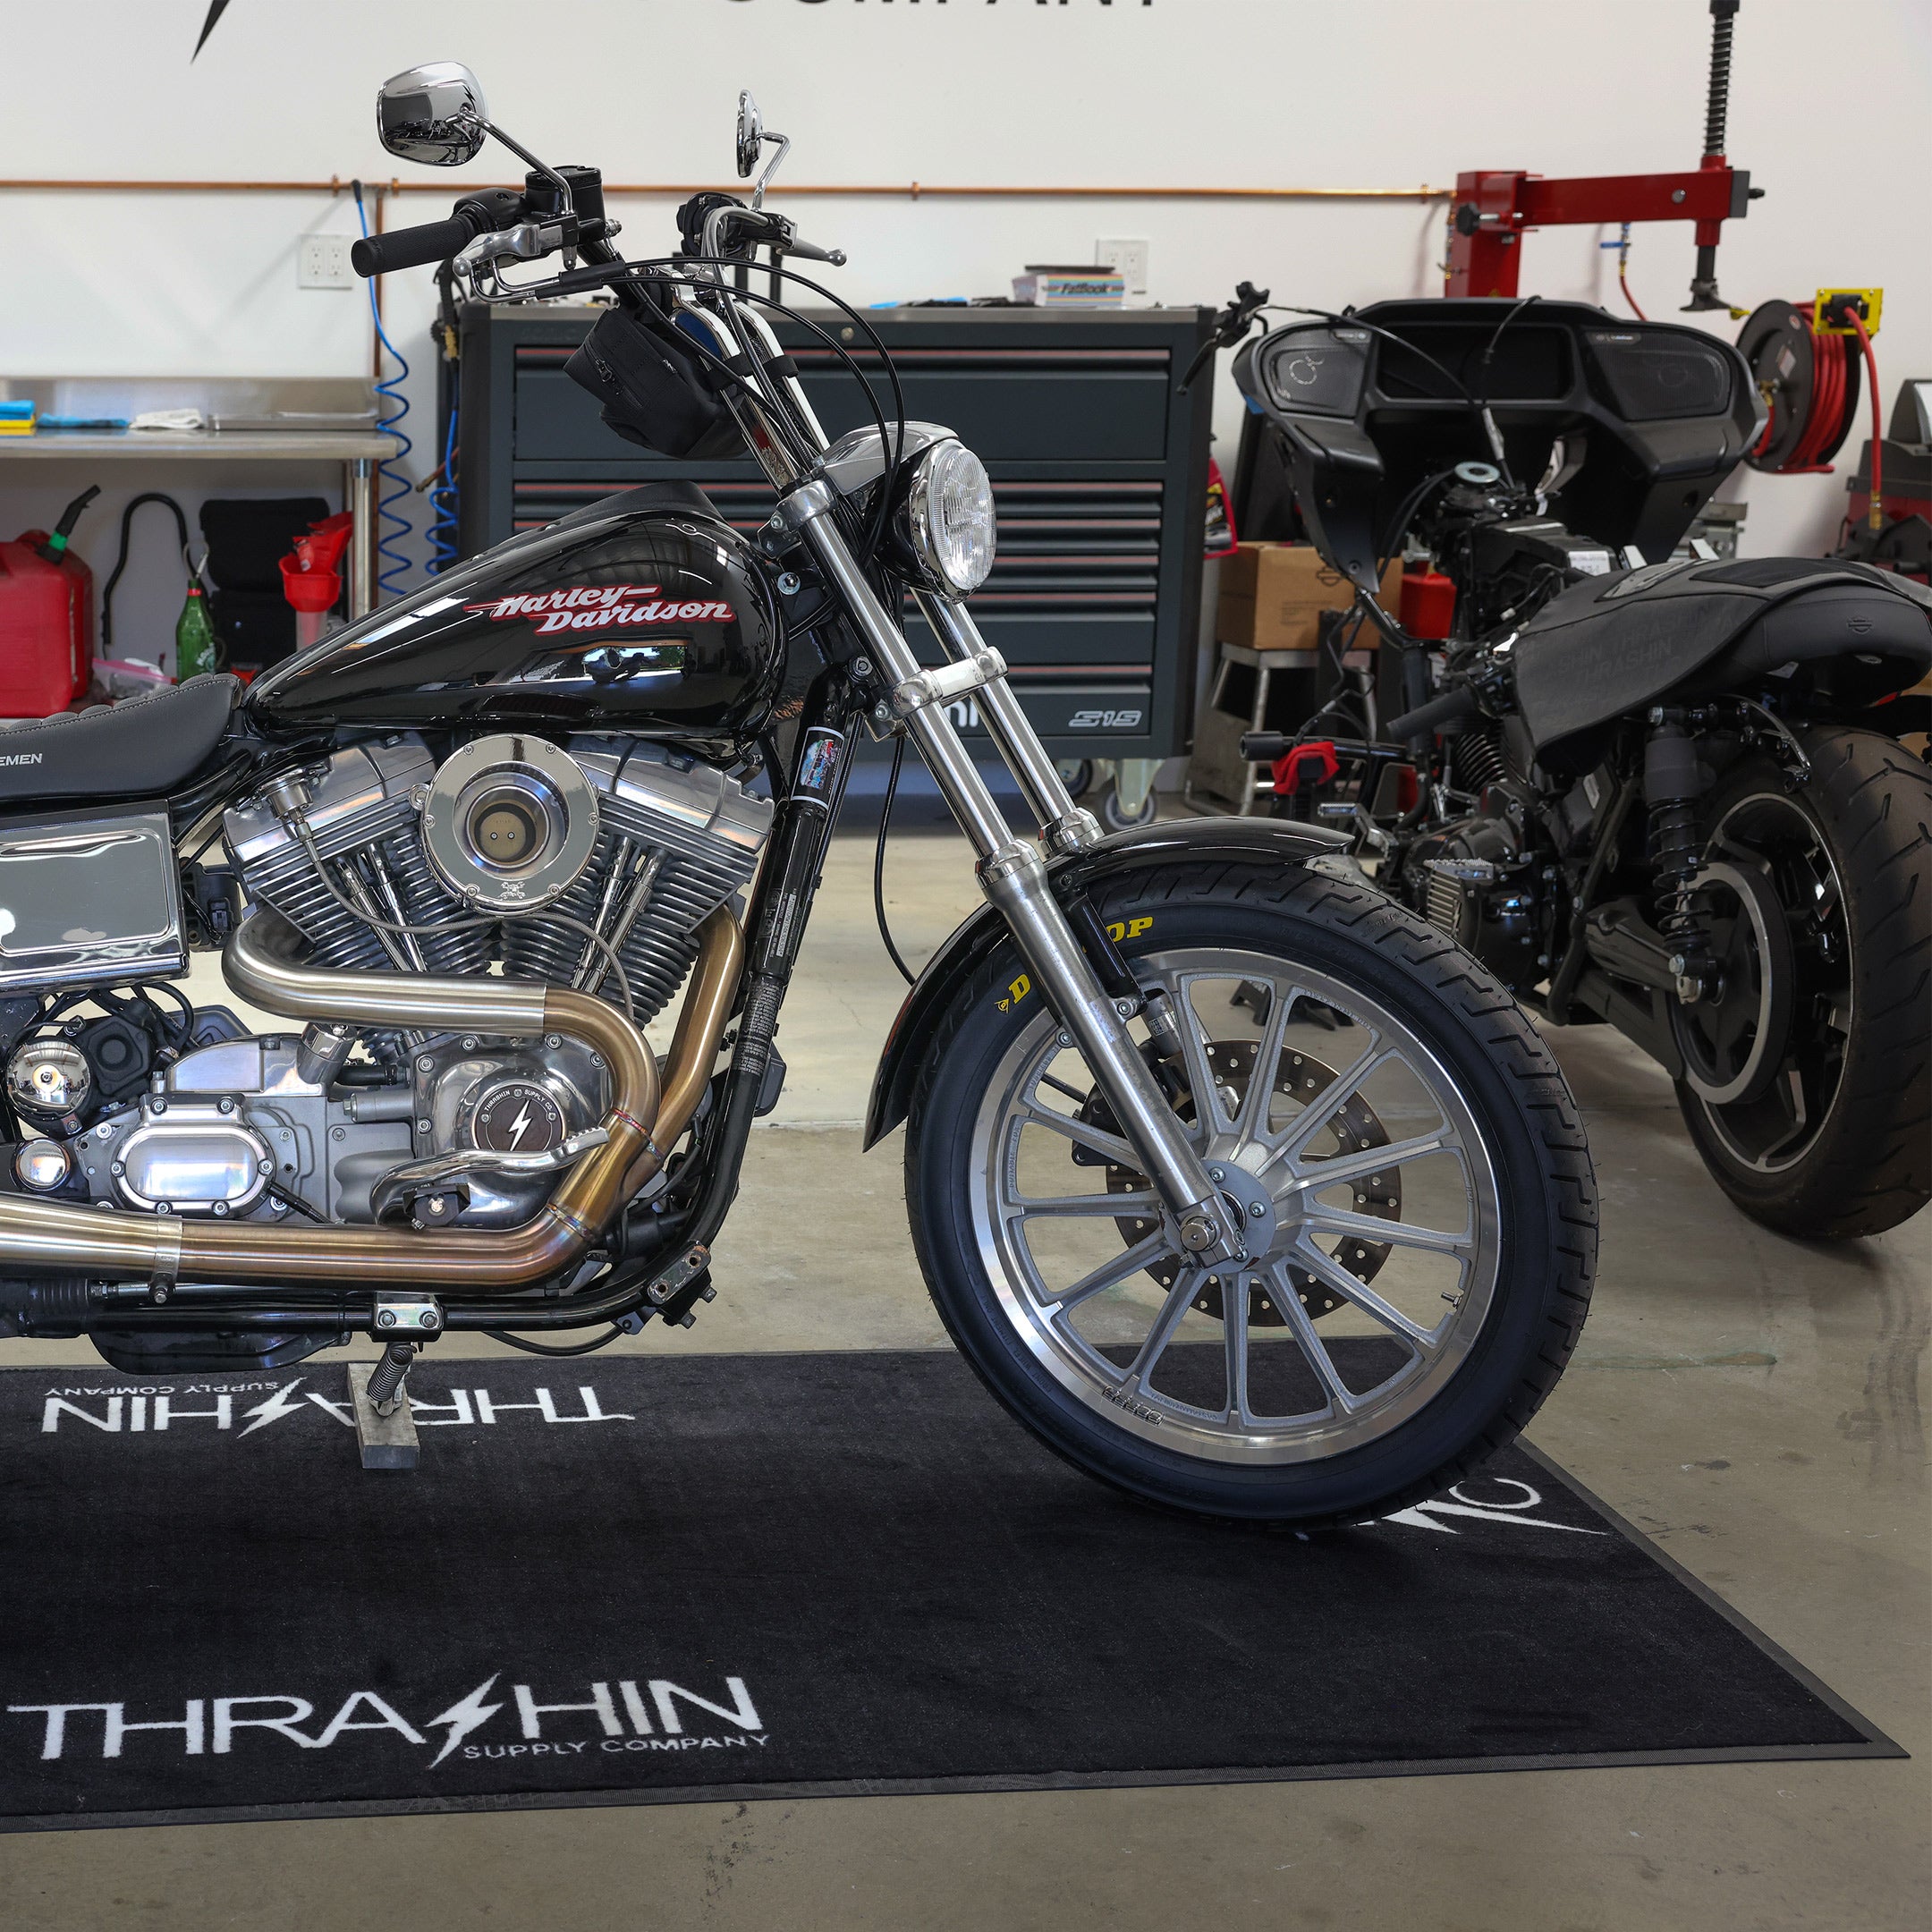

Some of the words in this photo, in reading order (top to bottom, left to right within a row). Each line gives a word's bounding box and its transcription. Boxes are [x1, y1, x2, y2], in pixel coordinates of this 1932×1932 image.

[535, 600, 734, 634] Davidson
[1068, 710, 1143, 727] S19
[484, 1089, 511, 1111] THRASHIN
[524, 1089, 546, 1103] SUPPLY
[44, 1386, 176, 1396] COMPANY
[183, 1381, 279, 1394] SUPPLY
[463, 1743, 586, 1759] SUPPLY
[600, 1734, 769, 1753] COMPANY
